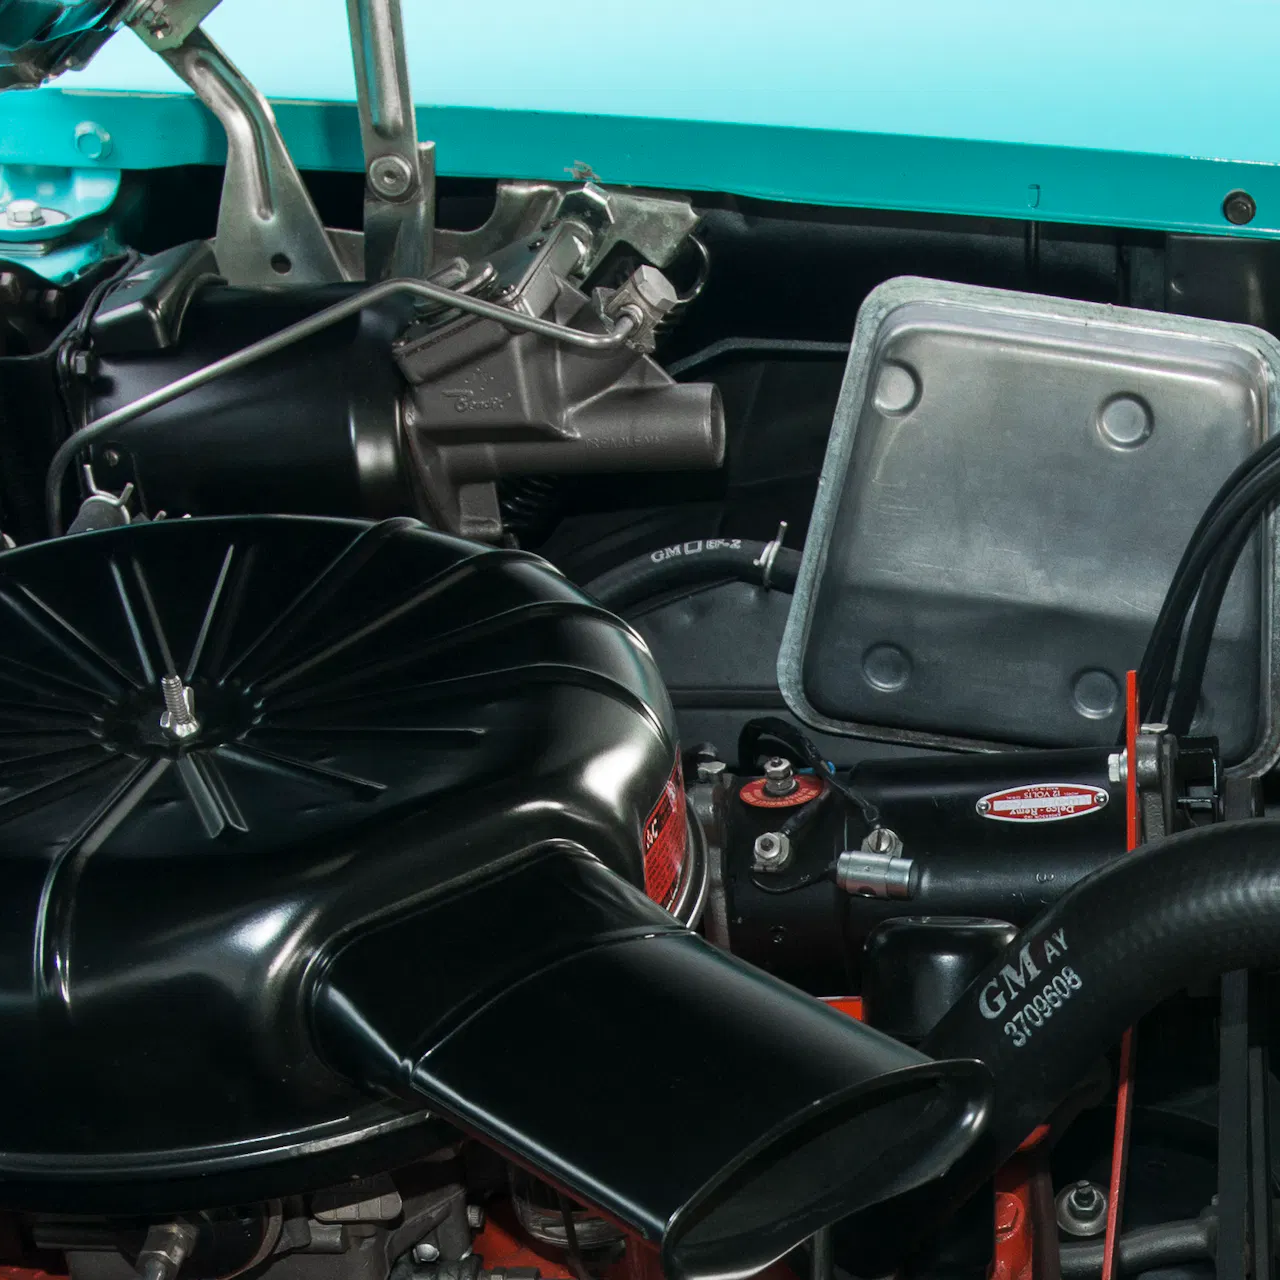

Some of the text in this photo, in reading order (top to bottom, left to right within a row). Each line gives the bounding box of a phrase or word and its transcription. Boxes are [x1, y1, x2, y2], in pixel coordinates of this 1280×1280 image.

[650, 544, 682, 563] GM
[1023, 790, 1061, 799] 12 VOLTS
[1010, 807, 1038, 816] Remy
[1046, 805, 1074, 814] Delco
[978, 928, 1068, 1019] GM AY
[1004, 965, 1083, 1047] 3709608
